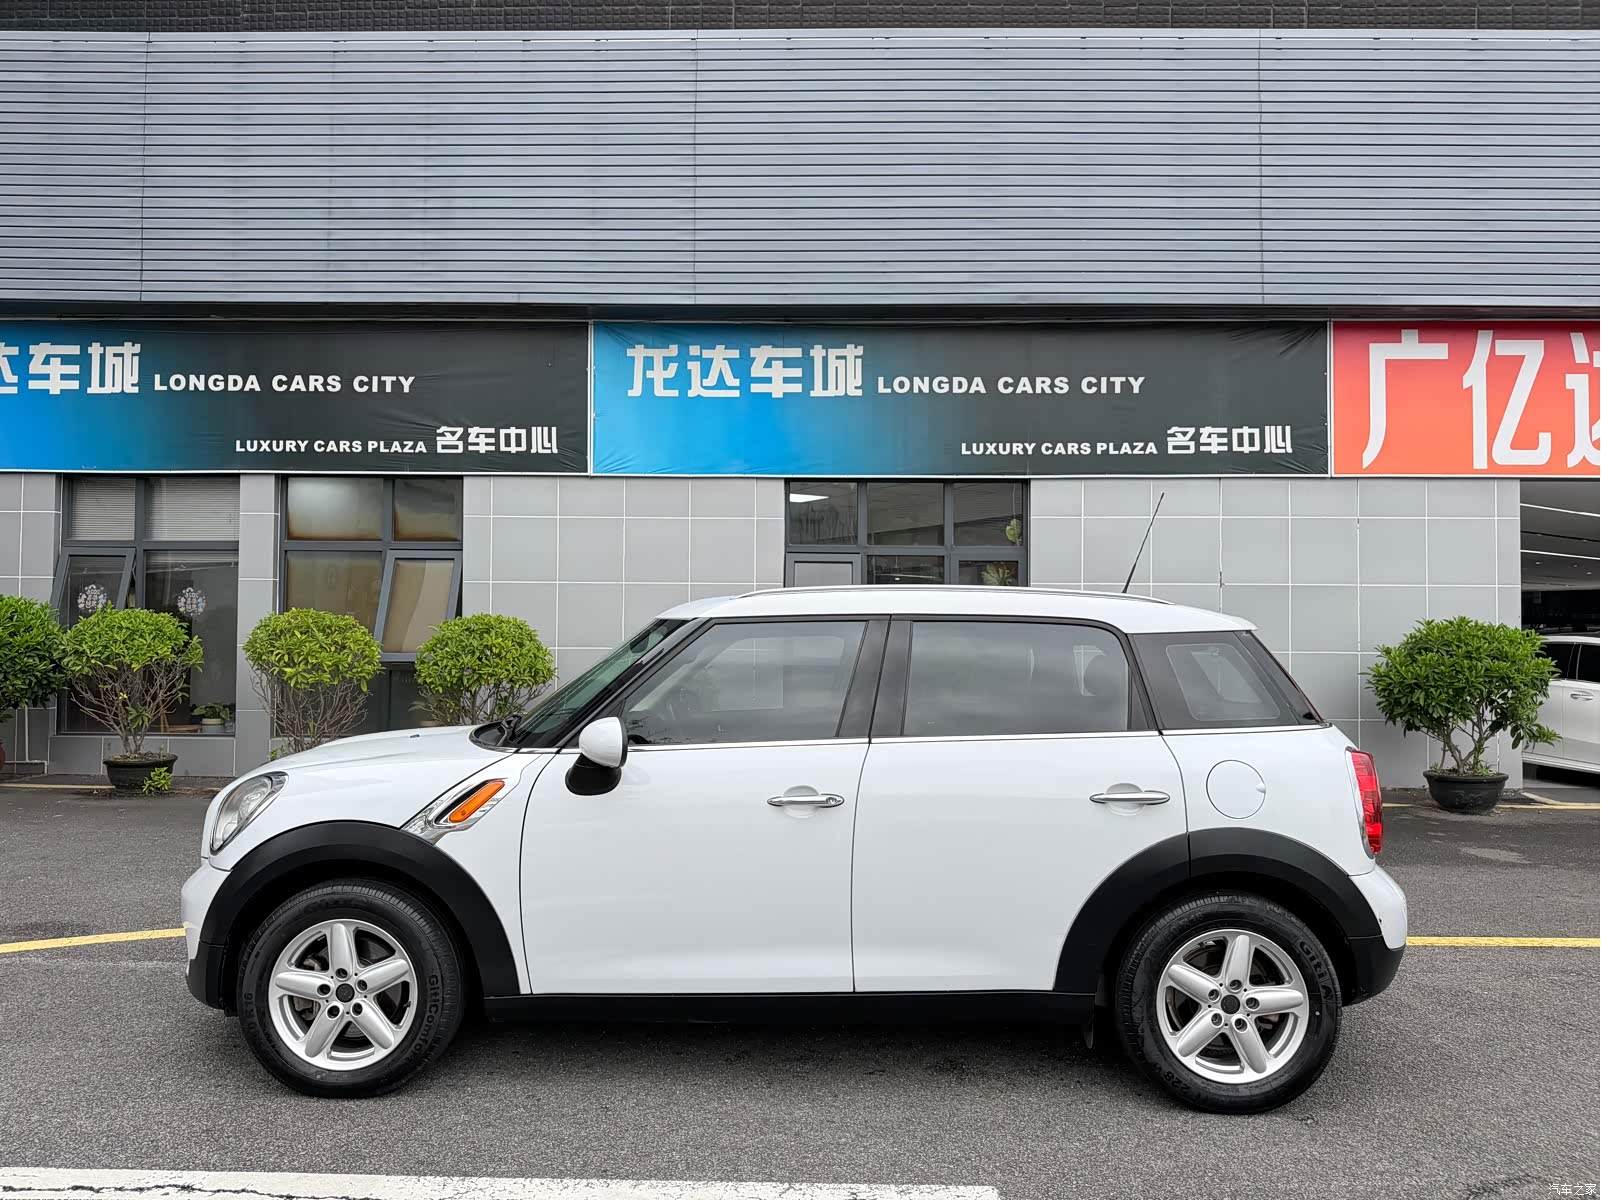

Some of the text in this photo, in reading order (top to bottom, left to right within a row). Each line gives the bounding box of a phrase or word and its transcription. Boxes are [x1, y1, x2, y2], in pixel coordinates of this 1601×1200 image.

[626, 343, 864, 398] 龙达车城
[154, 373, 416, 393] LONGDA CARS CITY
[877, 375, 1146, 394] LONGDA CARS CITY
[235, 439, 428, 453] LUXURY CARS PLAZA
[436, 426, 559, 454] 名车中心
[961, 441, 1158, 455] LUXURY CARS PLAZA
[1166, 425, 1293, 455] 名车中心
